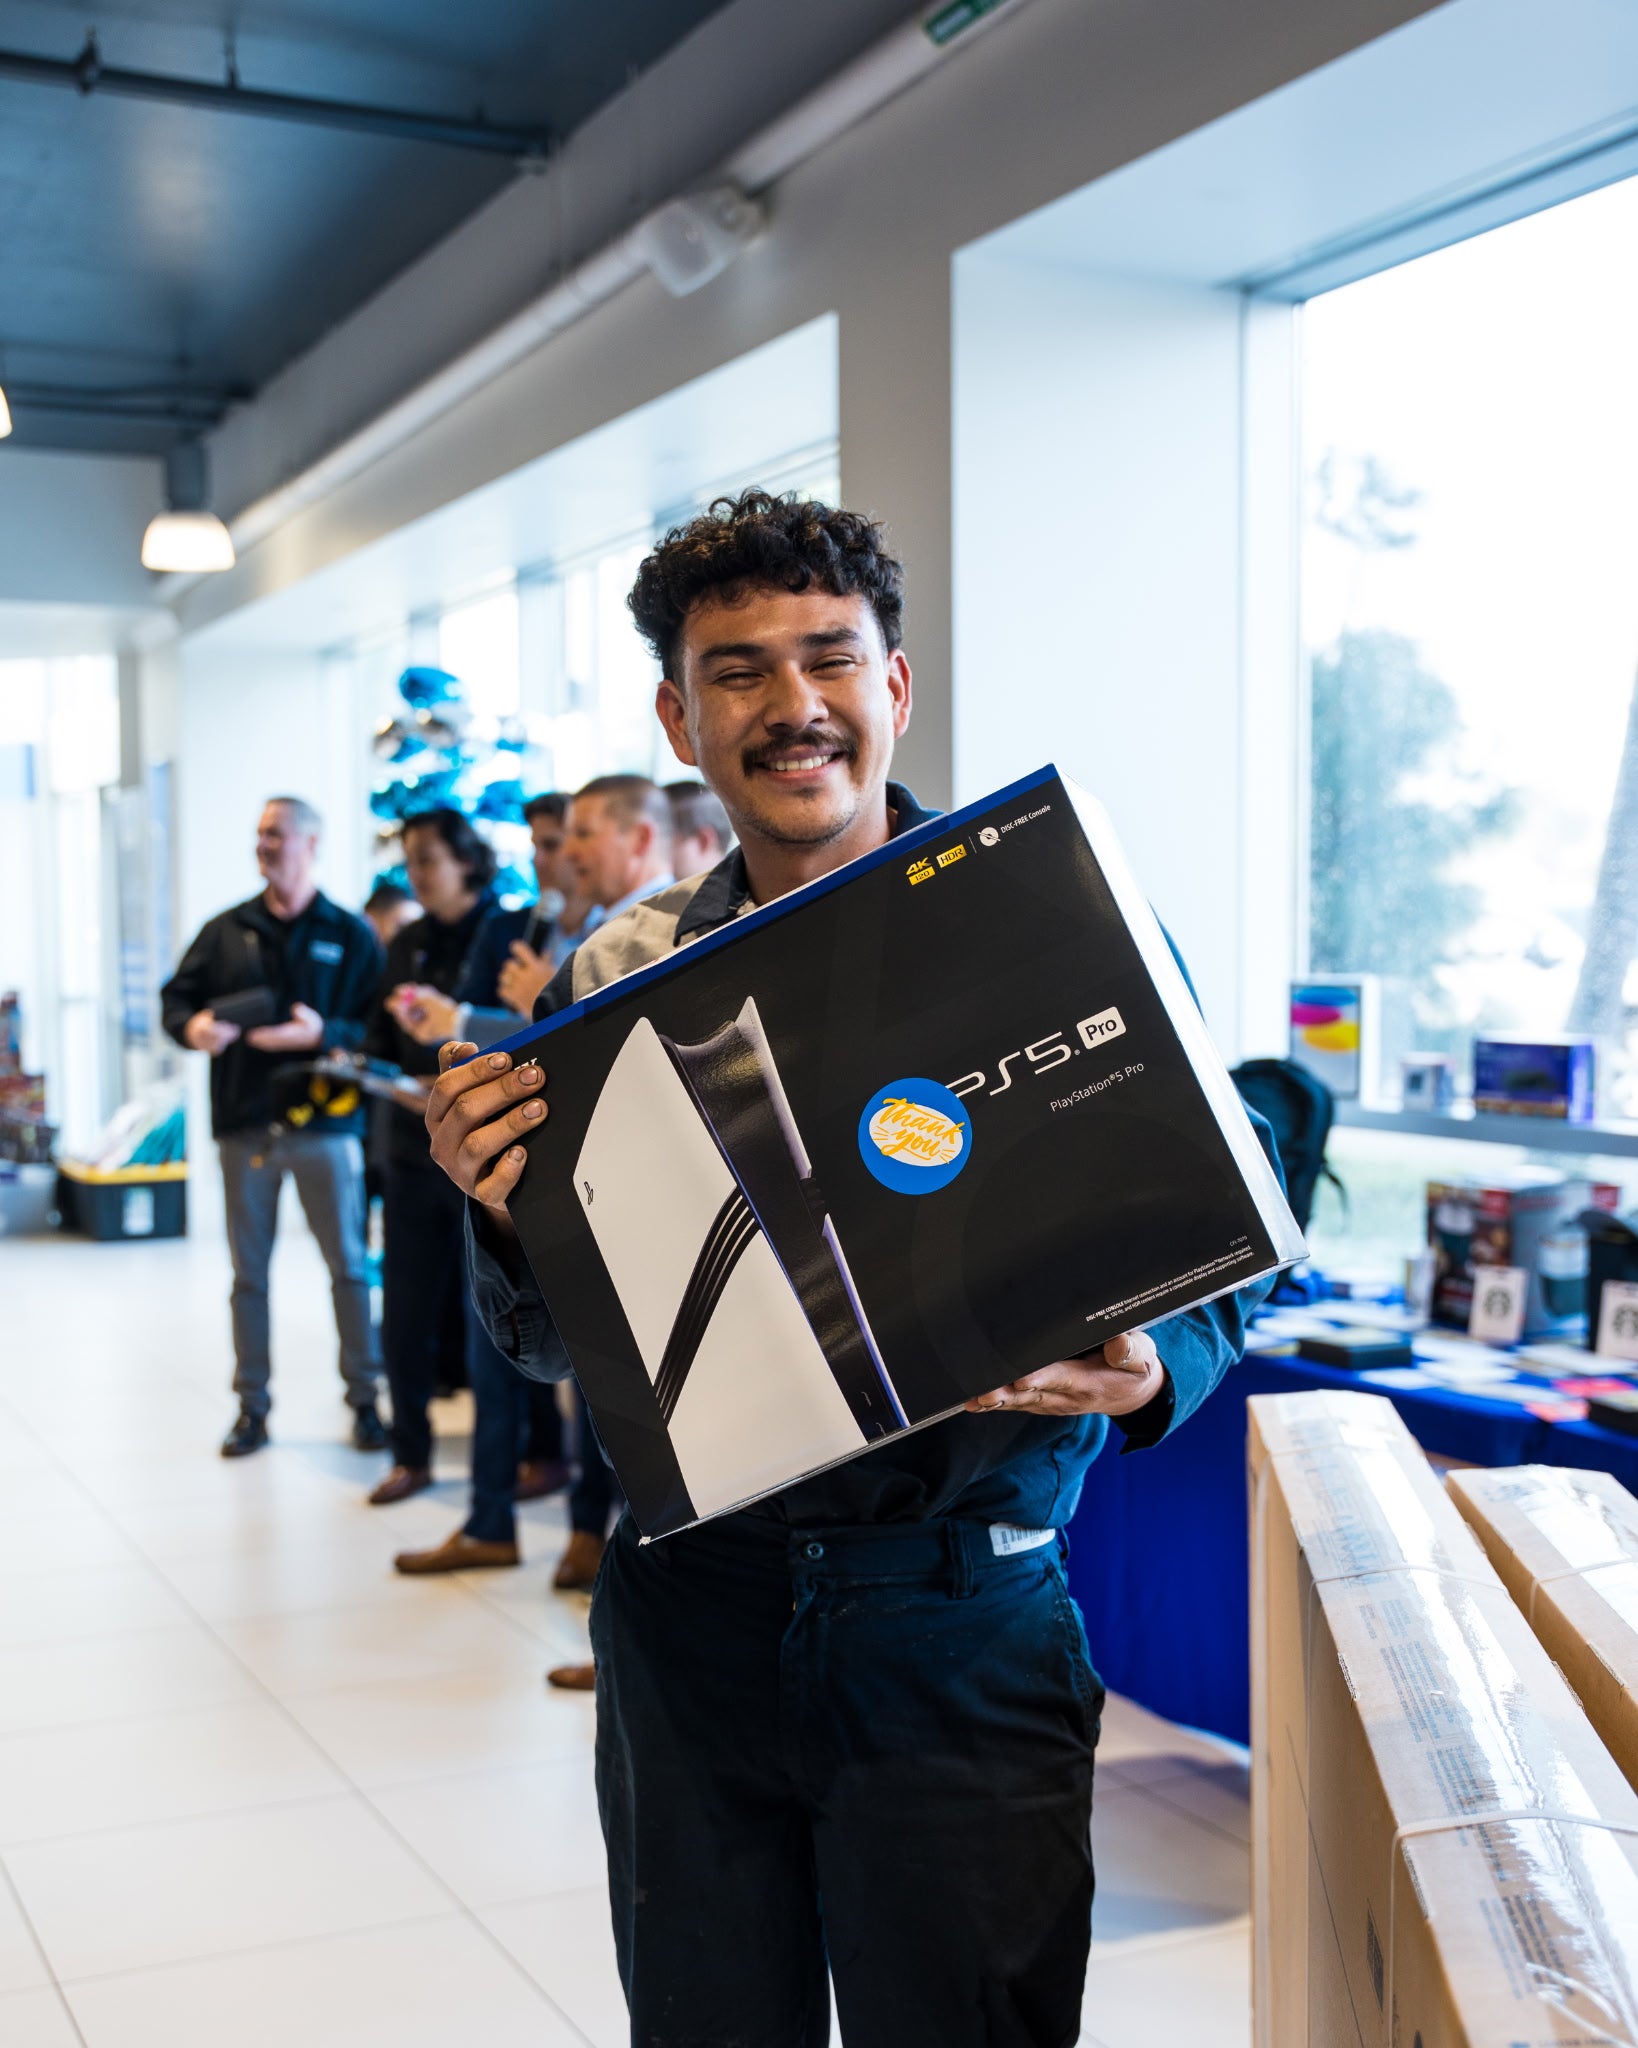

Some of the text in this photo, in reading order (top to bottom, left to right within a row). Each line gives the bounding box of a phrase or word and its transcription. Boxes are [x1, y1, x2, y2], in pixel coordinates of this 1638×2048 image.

[1000, 805, 1051, 834] DISC-FREE Console
[940, 848, 963, 864] HDR
[906, 857, 931, 875] 4K
[915, 870, 930, 881] 120
[1085, 1019, 1117, 1041] Pro
[1124, 1063, 1145, 1077] Pro
